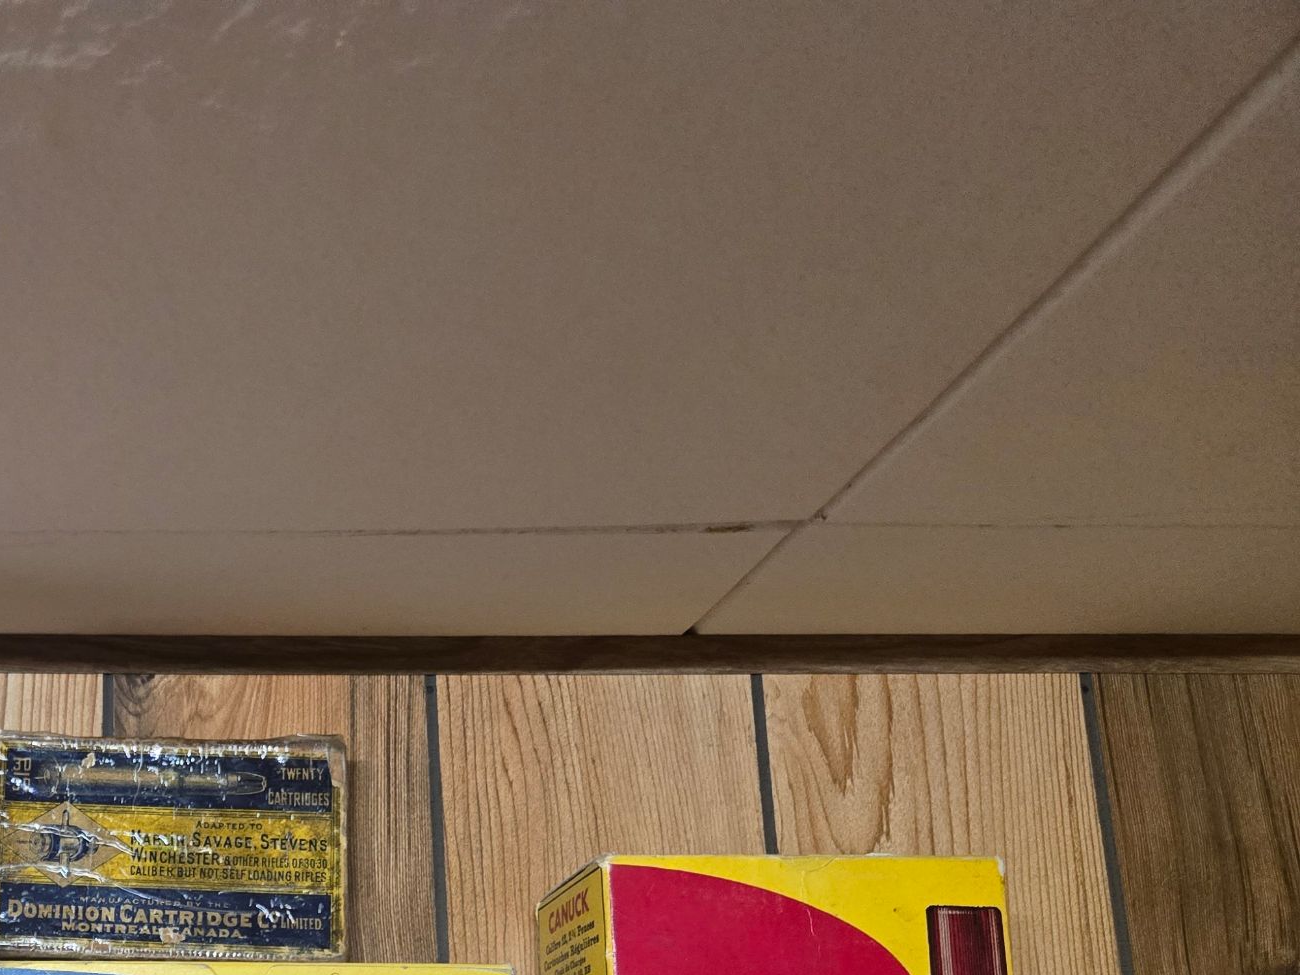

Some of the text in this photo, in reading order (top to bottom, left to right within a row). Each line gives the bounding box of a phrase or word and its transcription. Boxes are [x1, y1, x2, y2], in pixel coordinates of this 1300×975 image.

[280, 768, 323, 781] TWENTY
[268, 791, 329, 807] CARTRIDGES
[261, 834, 327, 851] STEVENS
[131, 866, 196, 877] CALIBER BUT
[8, 899, 252, 927] DOMINION CARTRIDGE
[549, 888, 589, 934] CANUCK
